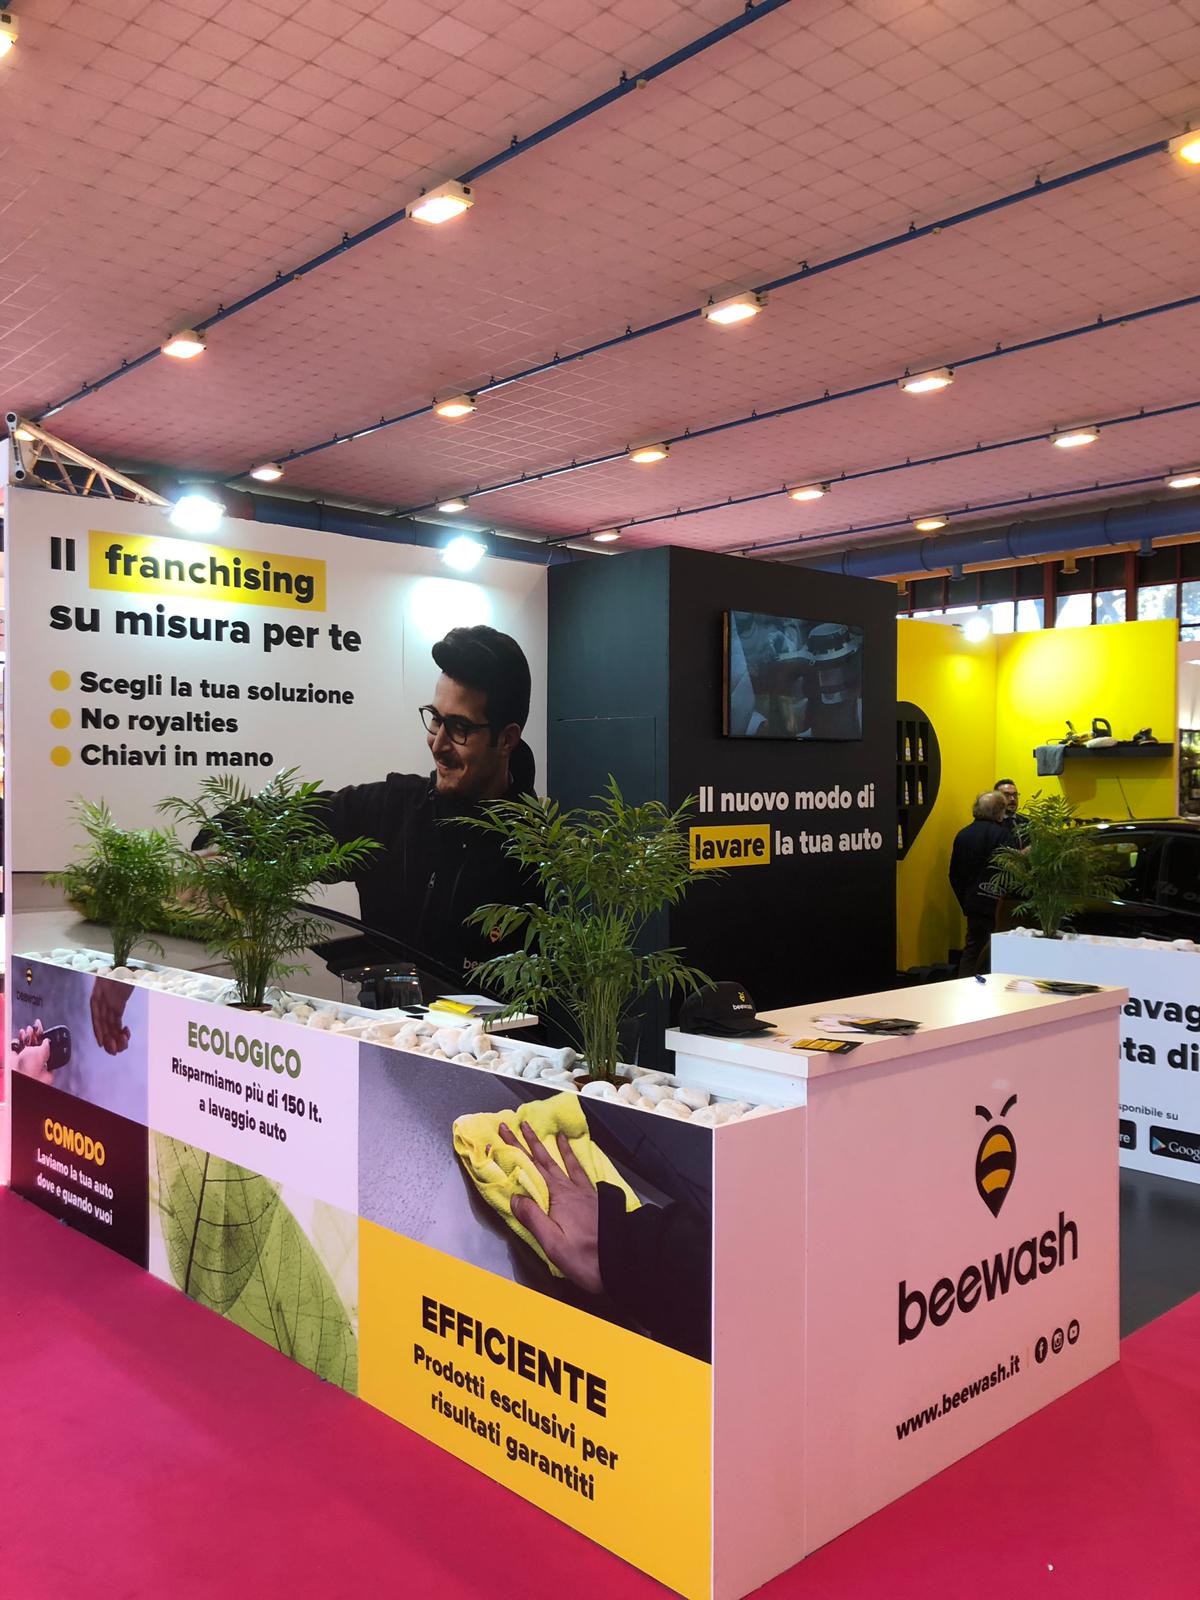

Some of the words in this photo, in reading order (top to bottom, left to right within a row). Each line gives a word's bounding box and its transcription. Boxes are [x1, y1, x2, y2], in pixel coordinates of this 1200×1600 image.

[50, 537, 75, 571] Il
[105, 544, 314, 603] franchising
[49, 604, 100, 632] su
[116, 604, 250, 643] misura
[264, 621, 319, 652] per
[329, 623, 362, 652] te
[80, 671, 162, 700] Scegli
[170, 676, 192, 697] la
[200, 680, 240, 699] tua
[247, 681, 354, 705] soluzione
[81, 708, 119, 730] No
[128, 711, 238, 736] royalties
[80, 744, 166, 766] Chiavi
[175, 745, 198, 766] in
[206, 748, 273, 767] mano
[700, 786, 713, 812] Il
[721, 791, 789, 812] nuovo
[795, 785, 852, 810] modo
[857, 783, 875, 808] di
[695, 834, 765, 860] lavare
[775, 830, 794, 855] la
[800, 831, 833, 854] tua
[839, 828, 882, 852] auto
[188, 1021, 301, 1079] ECOLOGICO
[1167, 1043, 1199, 1072] di
[172, 1057, 242, 1095] Risparmiamo
[246, 1082, 263, 1103] più
[267, 1089, 278, 1108] di
[282, 1093, 305, 1117] 150
[309, 1102, 322, 1123] lt.
[199, 1099, 206, 1112] a
[209, 1098, 256, 1131] lavaggio
[259, 1121, 287, 1142] auto
[1166, 1112, 1179, 1121] su
[45, 1119, 105, 1166] COMODO
[37, 1148, 68, 1177] Laviamo
[70, 1164, 78, 1181] la
[79, 1170, 92, 1189] tua
[94, 1180, 113, 1200] auto
[37, 1172, 55, 1193] dove
[56, 1185, 61, 1197] e
[62, 1188, 92, 1214] quando
[94, 1205, 112, 1226] vuoi
[898, 1211, 1078, 1345] beewash
[422, 1295, 607, 1418] EFFICIENTE
[414, 1343, 485, 1400] Prodotti
[490, 1387, 575, 1449] esclusivi
[582, 1436, 618, 1471] per
[896, 1355, 1020, 1440] www.beewash.it
[431, 1391, 500, 1446] risultati
[506, 1435, 594, 1501] garantiti
